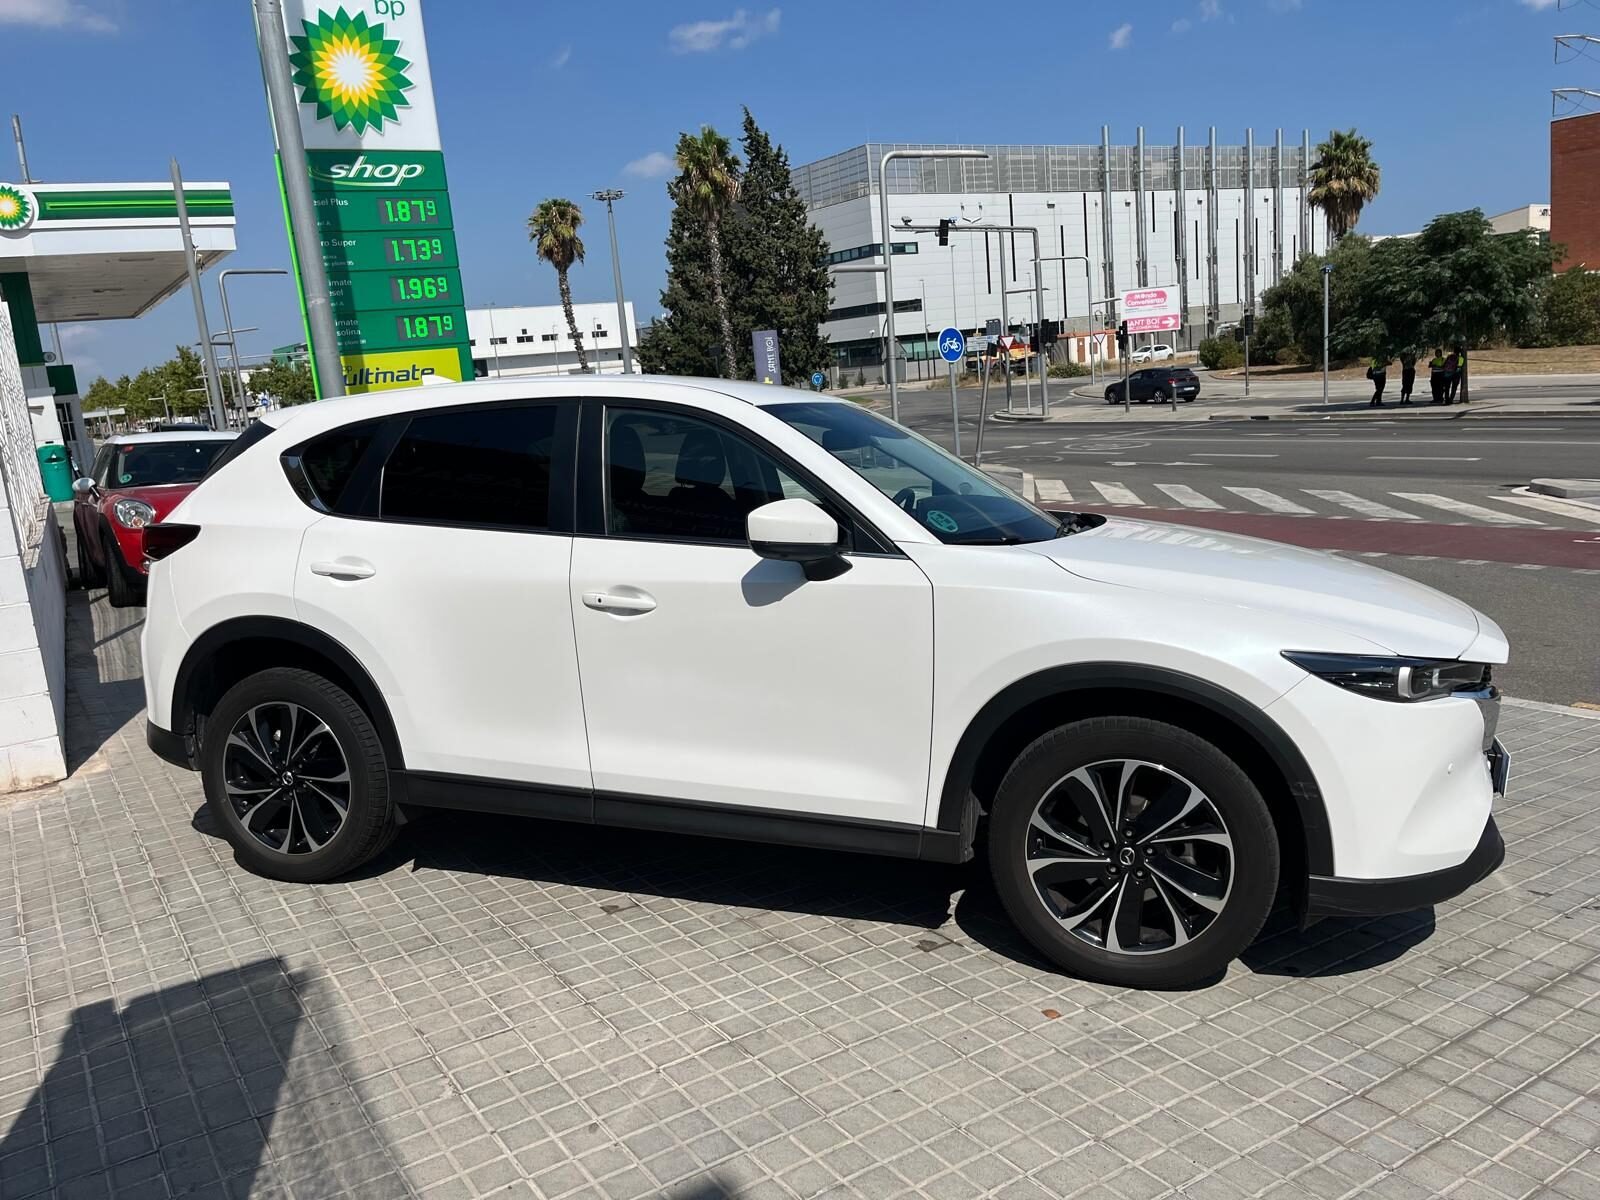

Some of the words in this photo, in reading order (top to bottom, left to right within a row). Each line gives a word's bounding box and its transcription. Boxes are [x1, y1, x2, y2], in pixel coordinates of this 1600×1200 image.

[374, 0, 405, 21] bp
[330, 156, 423, 187] shop
[330, 198, 349, 206] Plus
[331, 239, 357, 247] Super
[344, 364, 435, 386] ultimate
